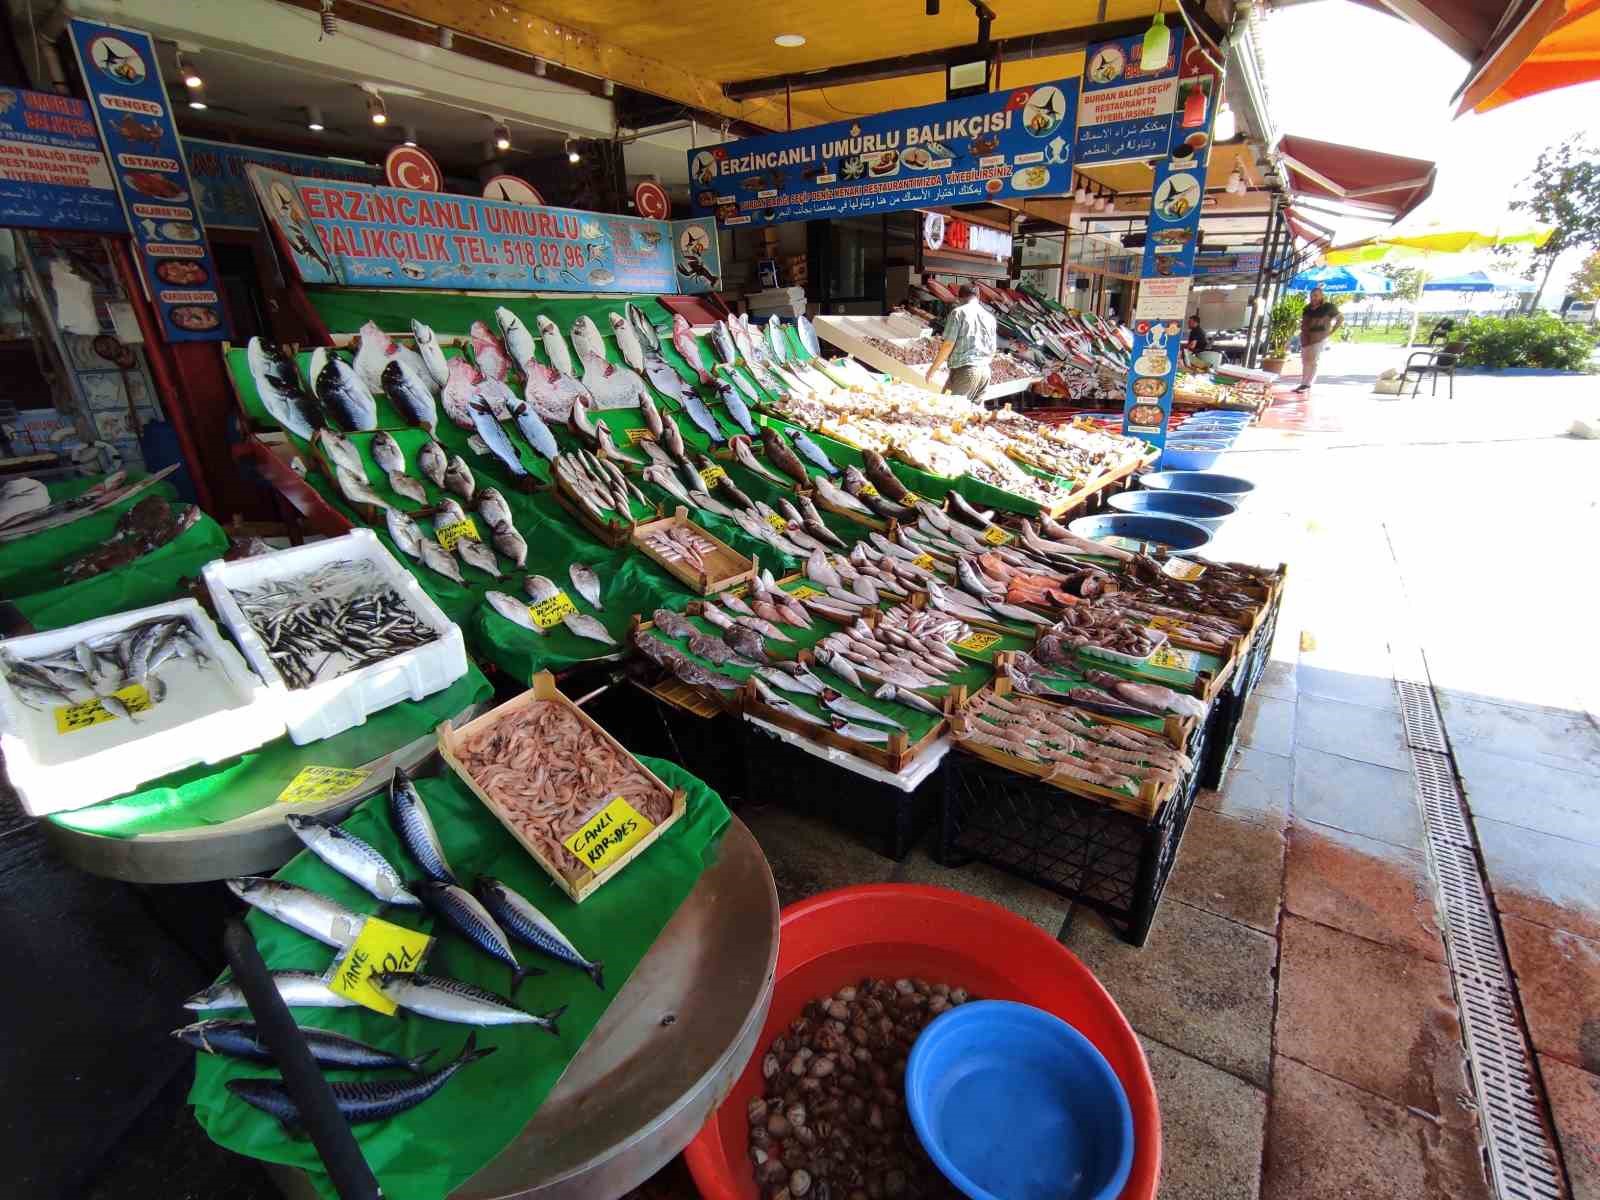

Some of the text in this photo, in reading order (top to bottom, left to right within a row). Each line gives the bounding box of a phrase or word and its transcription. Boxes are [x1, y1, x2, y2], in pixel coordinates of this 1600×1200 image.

[720, 144, 816, 176] ERZİNCANLI
[906, 110, 1012, 145] BALIKÇISI
[485, 206, 580, 240] UMURLU
[452, 234, 497, 265] TEL:
[502, 239, 536, 266] 518
[540, 241, 561, 268] 82
[565, 245, 585, 269] 96
[573, 812, 613, 852] CANLI
